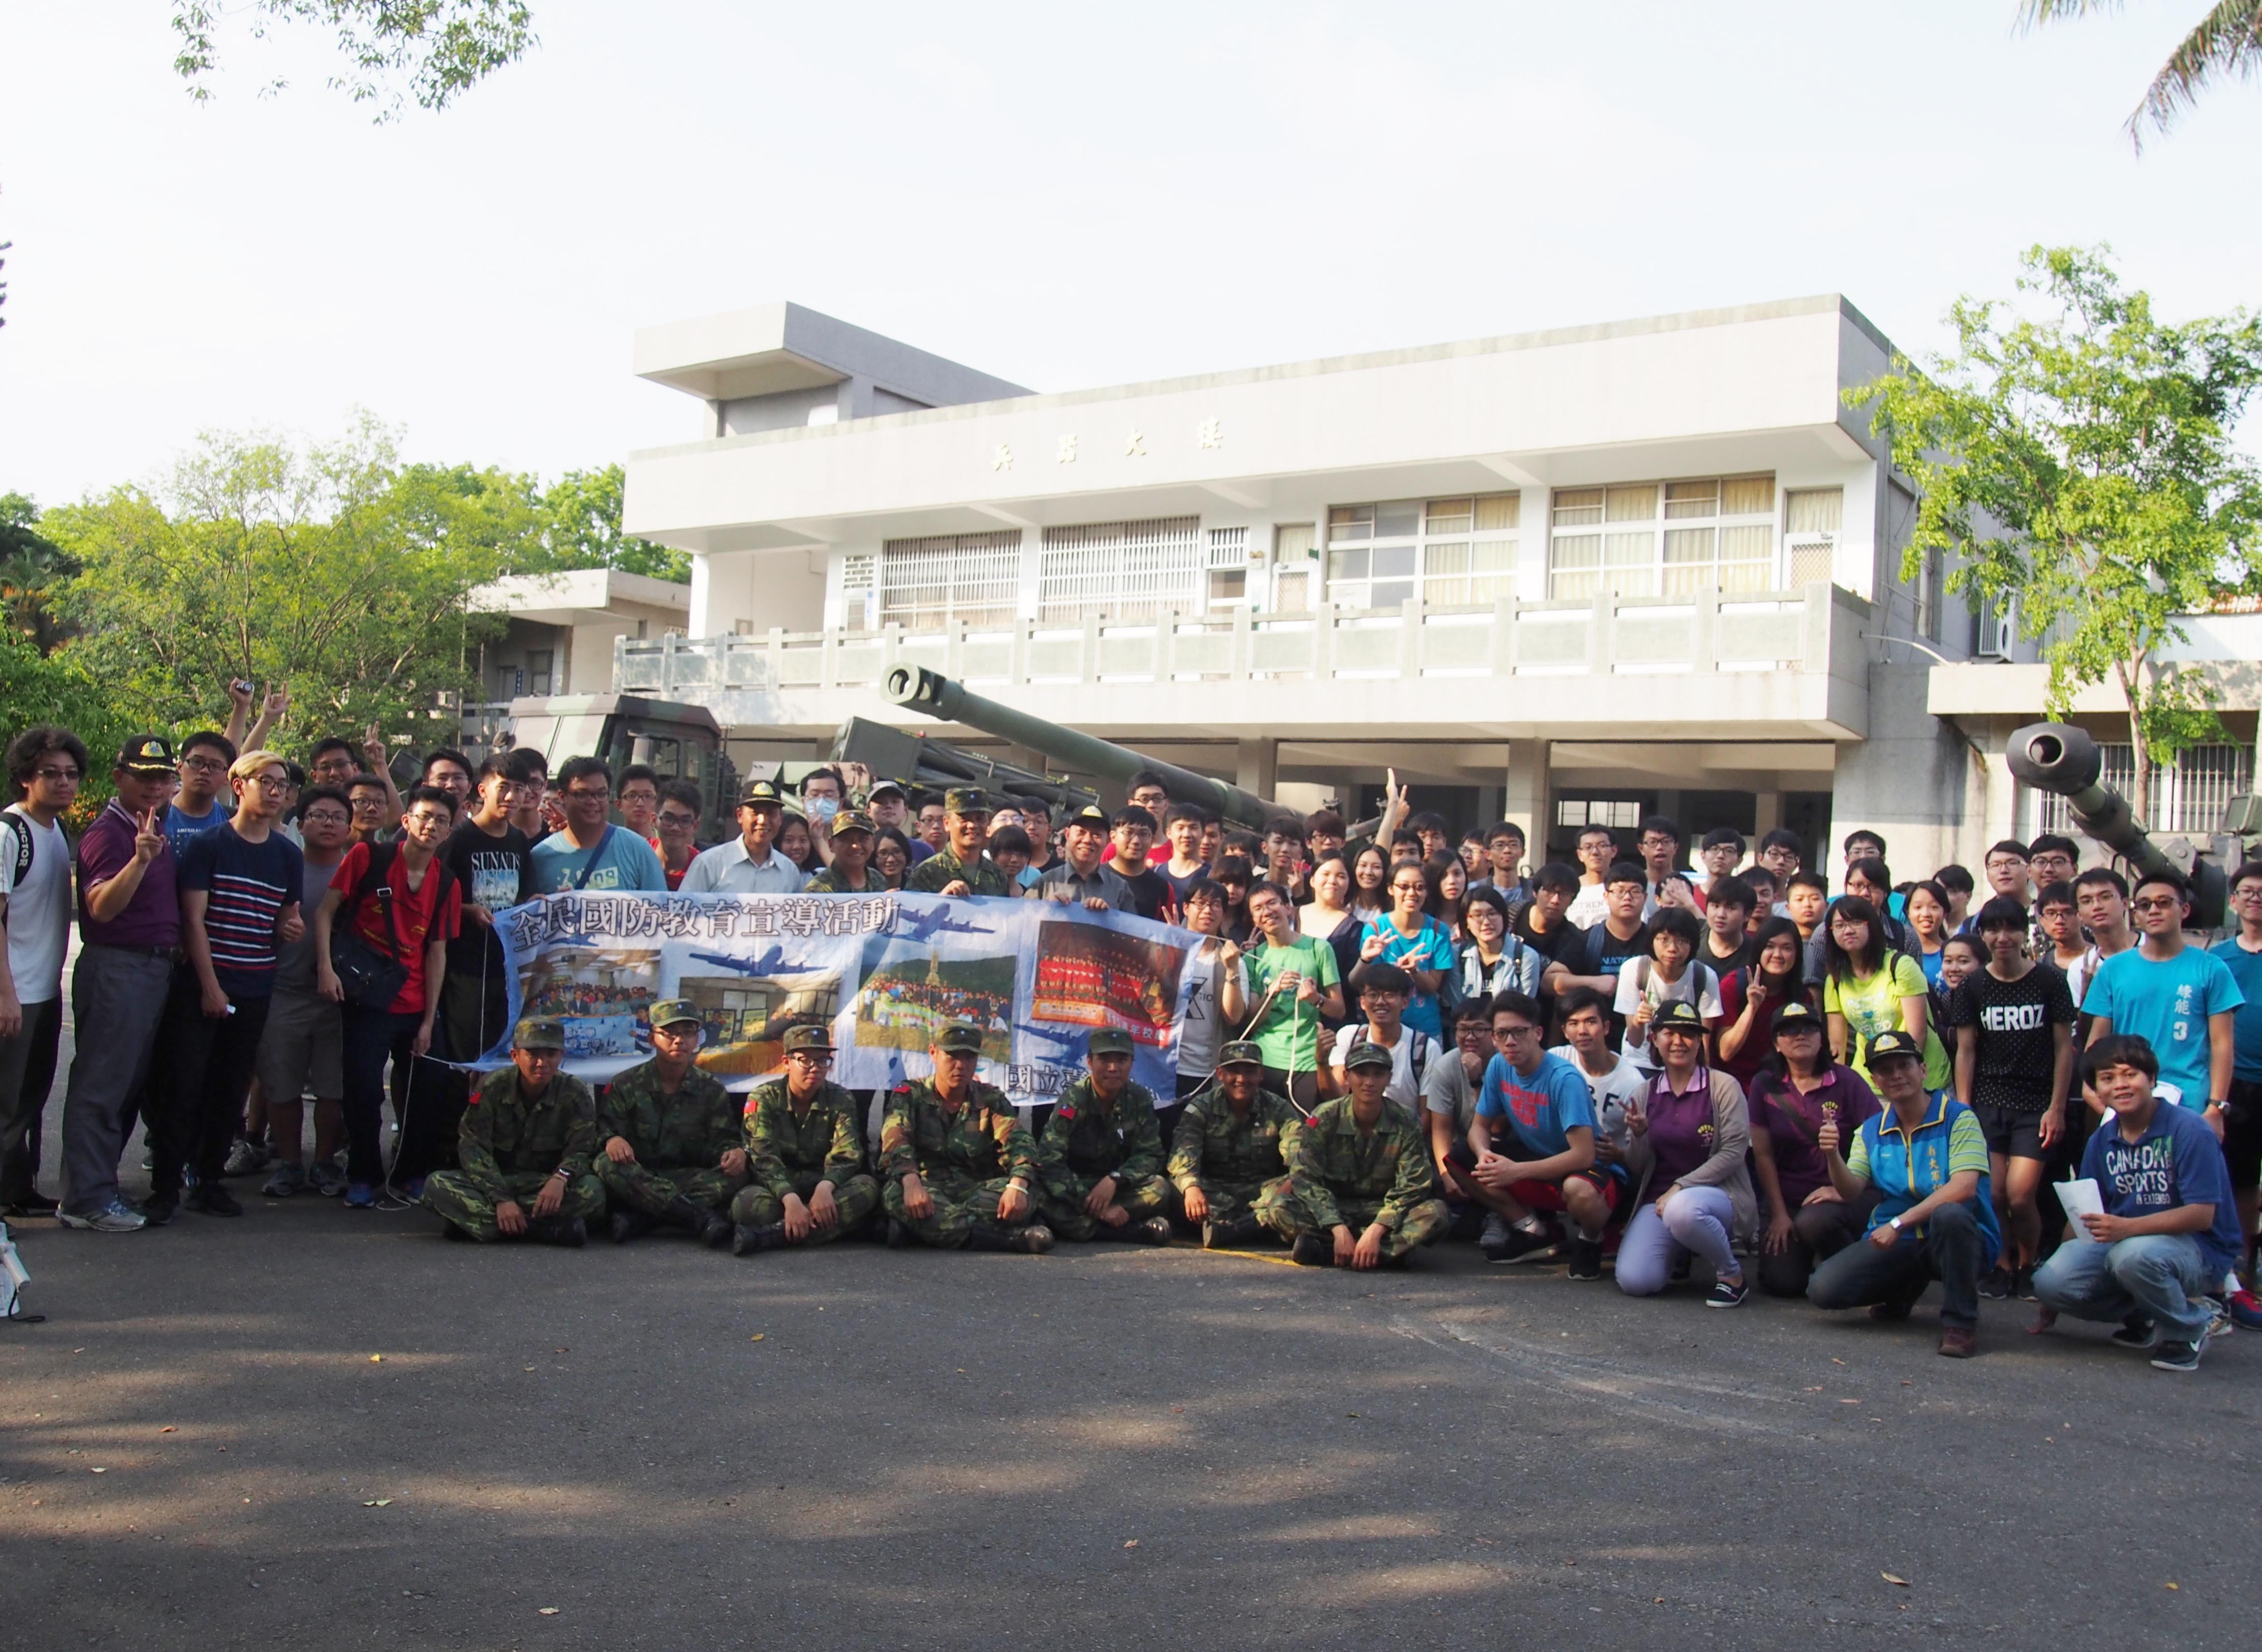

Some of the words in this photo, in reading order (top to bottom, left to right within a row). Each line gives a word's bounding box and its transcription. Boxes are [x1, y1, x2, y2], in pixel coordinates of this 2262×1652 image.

[18, 821, 29, 866] VICTOR
[511, 896, 900, 952] 全民國防教育宣導活動
[1980, 1004, 2044, 1031] HEROZ
[2173, 1021, 2188, 1040] 3
[2106, 1145, 2165, 1176] CANADA
[2115, 1170, 2168, 1194] SPORTS
